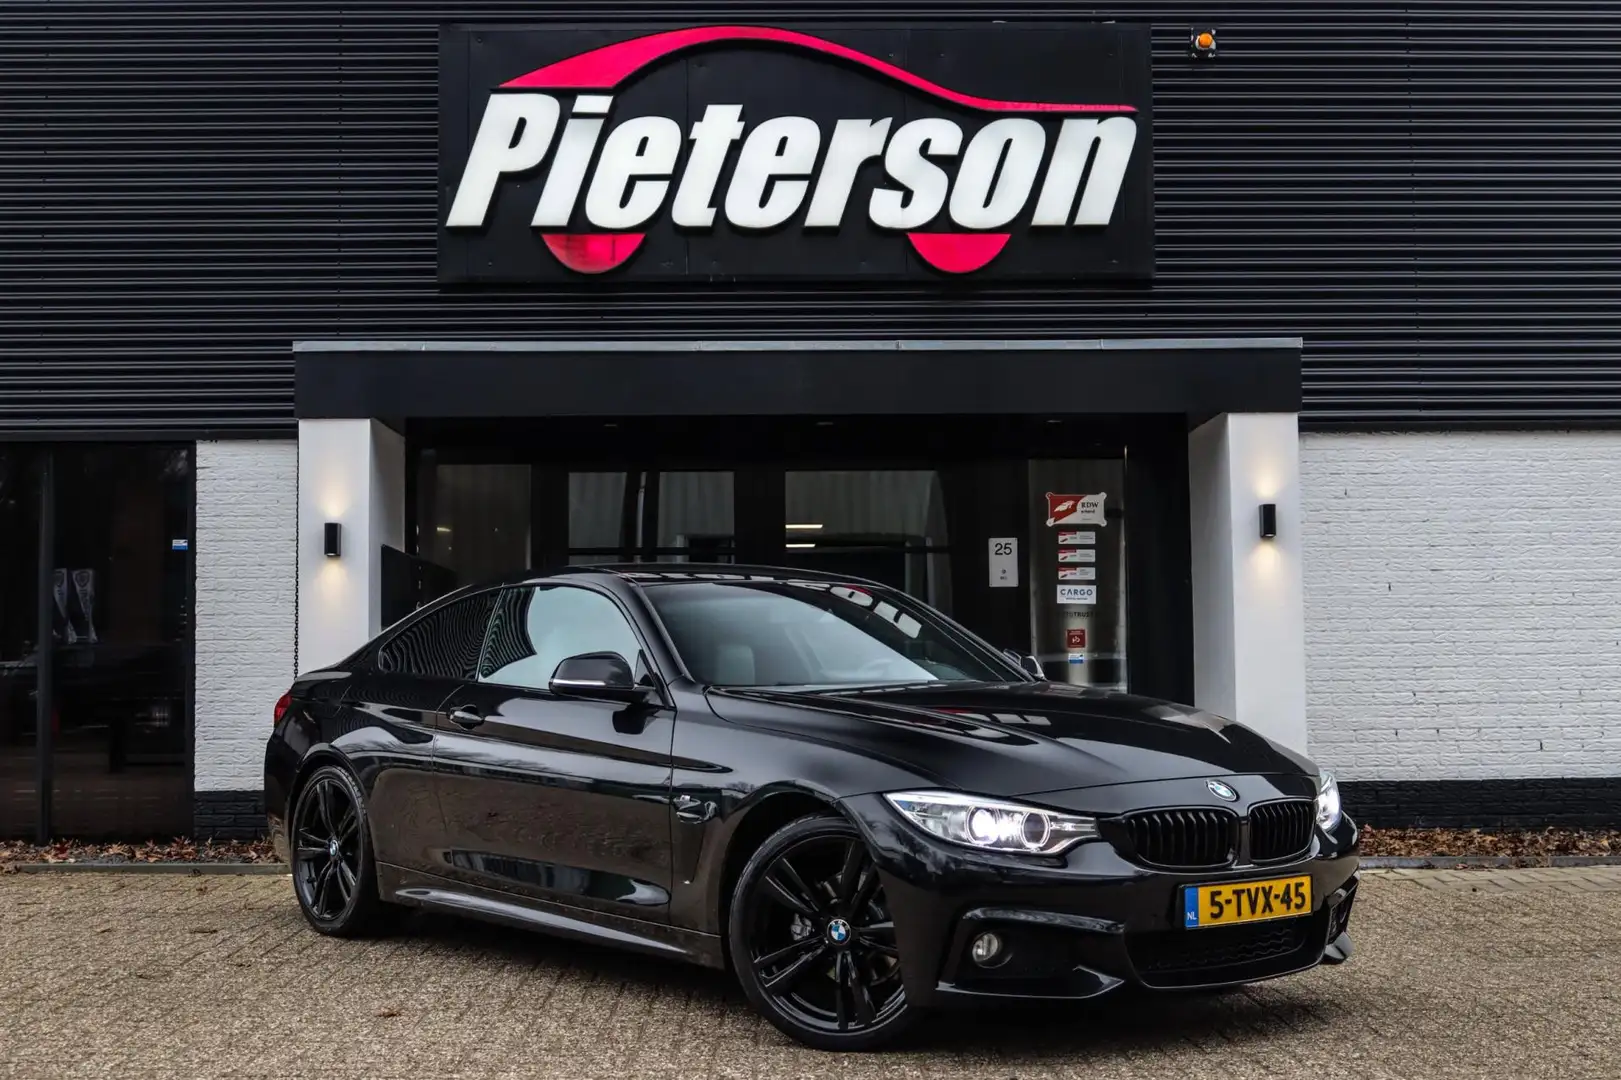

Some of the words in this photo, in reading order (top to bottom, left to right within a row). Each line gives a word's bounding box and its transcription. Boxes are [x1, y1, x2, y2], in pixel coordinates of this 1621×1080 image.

[444, 93, 1137, 229] Pieterson
[995, 542, 1013, 556] 25
[1060, 588, 1093, 596] CARGO
[1210, 882, 1306, 919] 5-TVX-45
[1187, 911, 1197, 920] NL
